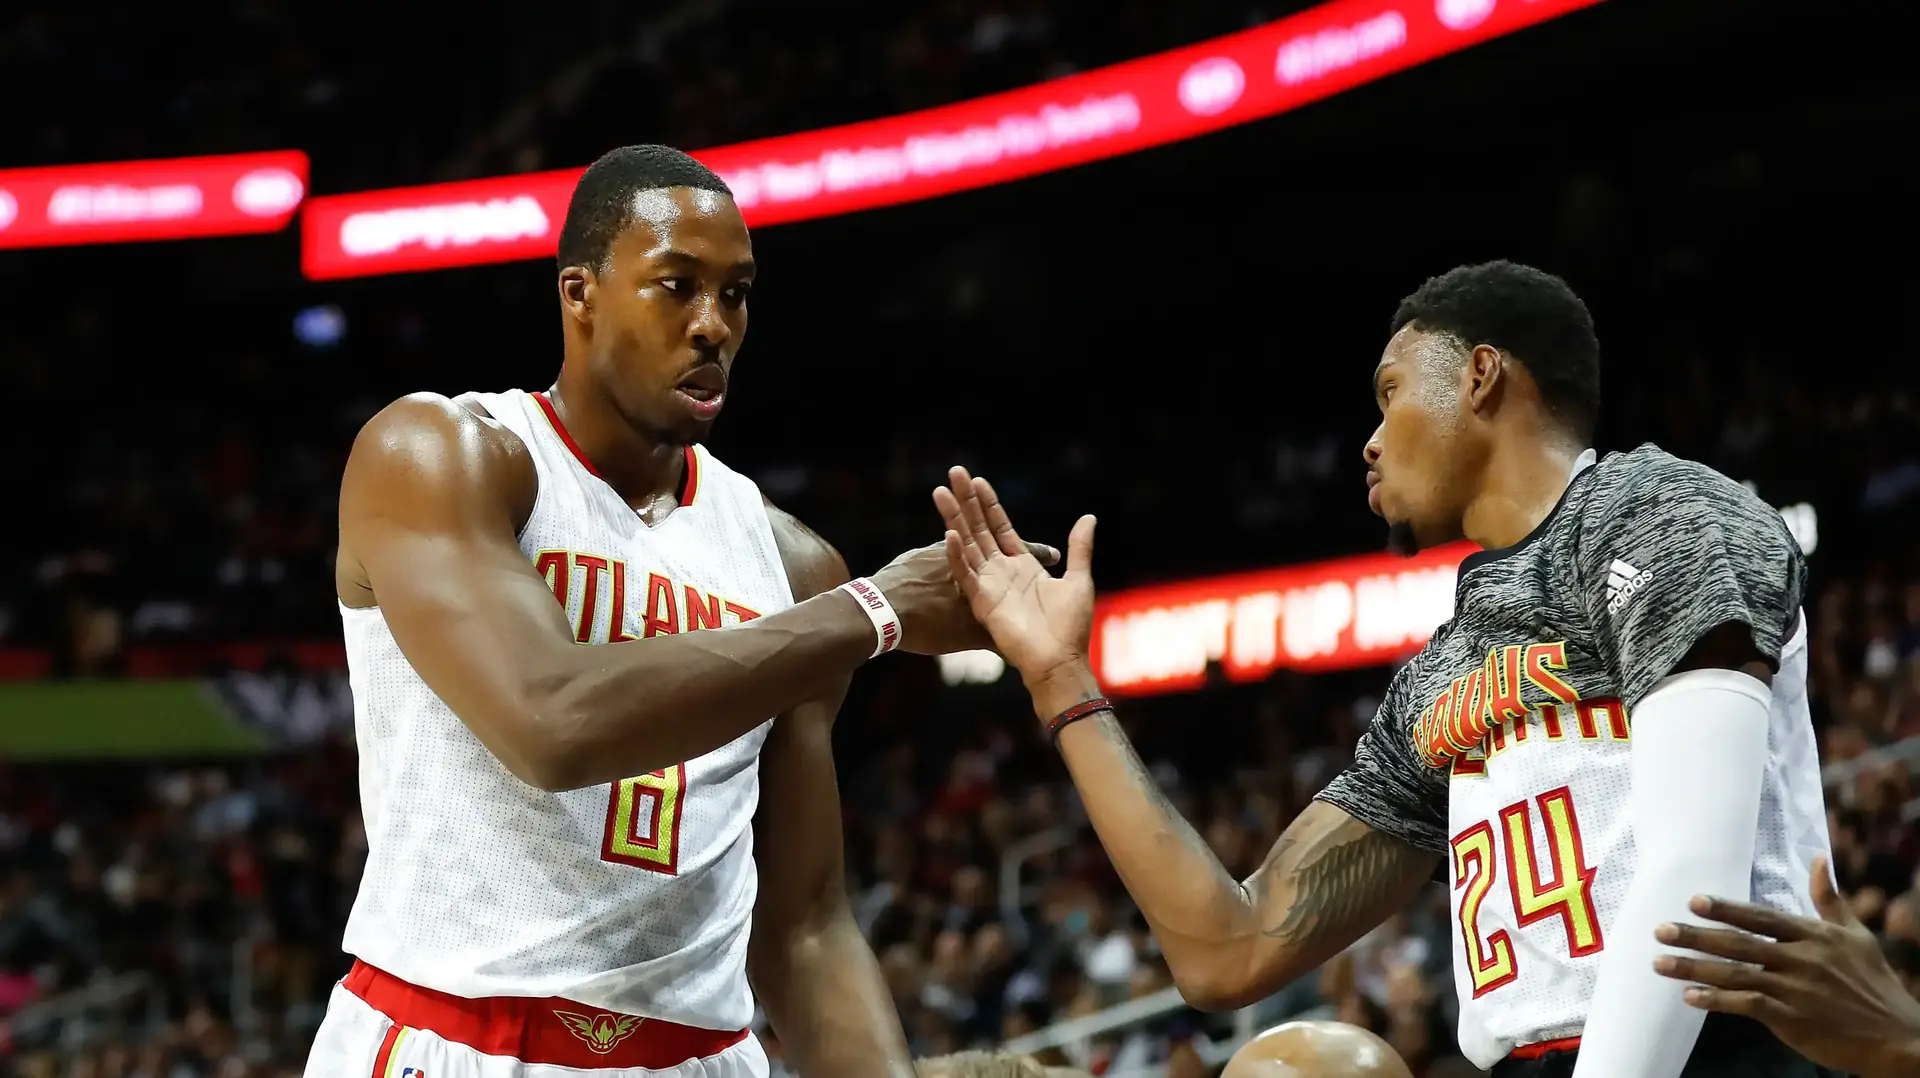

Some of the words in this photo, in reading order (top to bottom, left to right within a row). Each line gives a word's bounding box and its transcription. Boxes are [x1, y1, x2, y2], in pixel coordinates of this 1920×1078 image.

[1607, 569, 1654, 615] adidas
[1412, 641, 1581, 769] HAWKS
[1449, 785, 1605, 1001] 24
